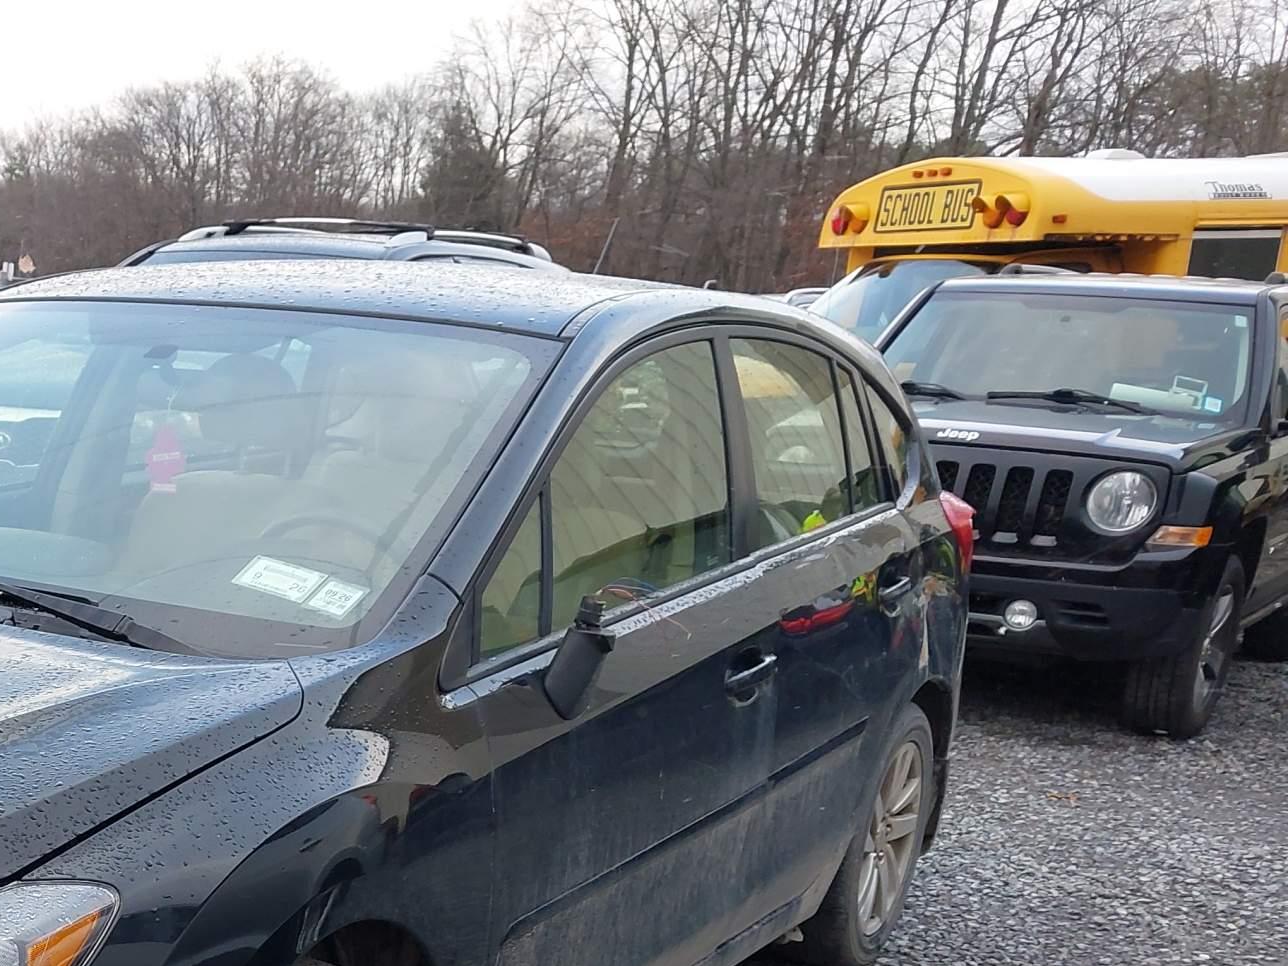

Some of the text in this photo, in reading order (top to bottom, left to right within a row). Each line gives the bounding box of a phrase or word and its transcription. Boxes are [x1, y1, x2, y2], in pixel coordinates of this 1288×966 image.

[1203, 181, 1264, 192] Thomas
[880, 188, 975, 227] SCHOOL BUS
[936, 428, 980, 441] Jeep
